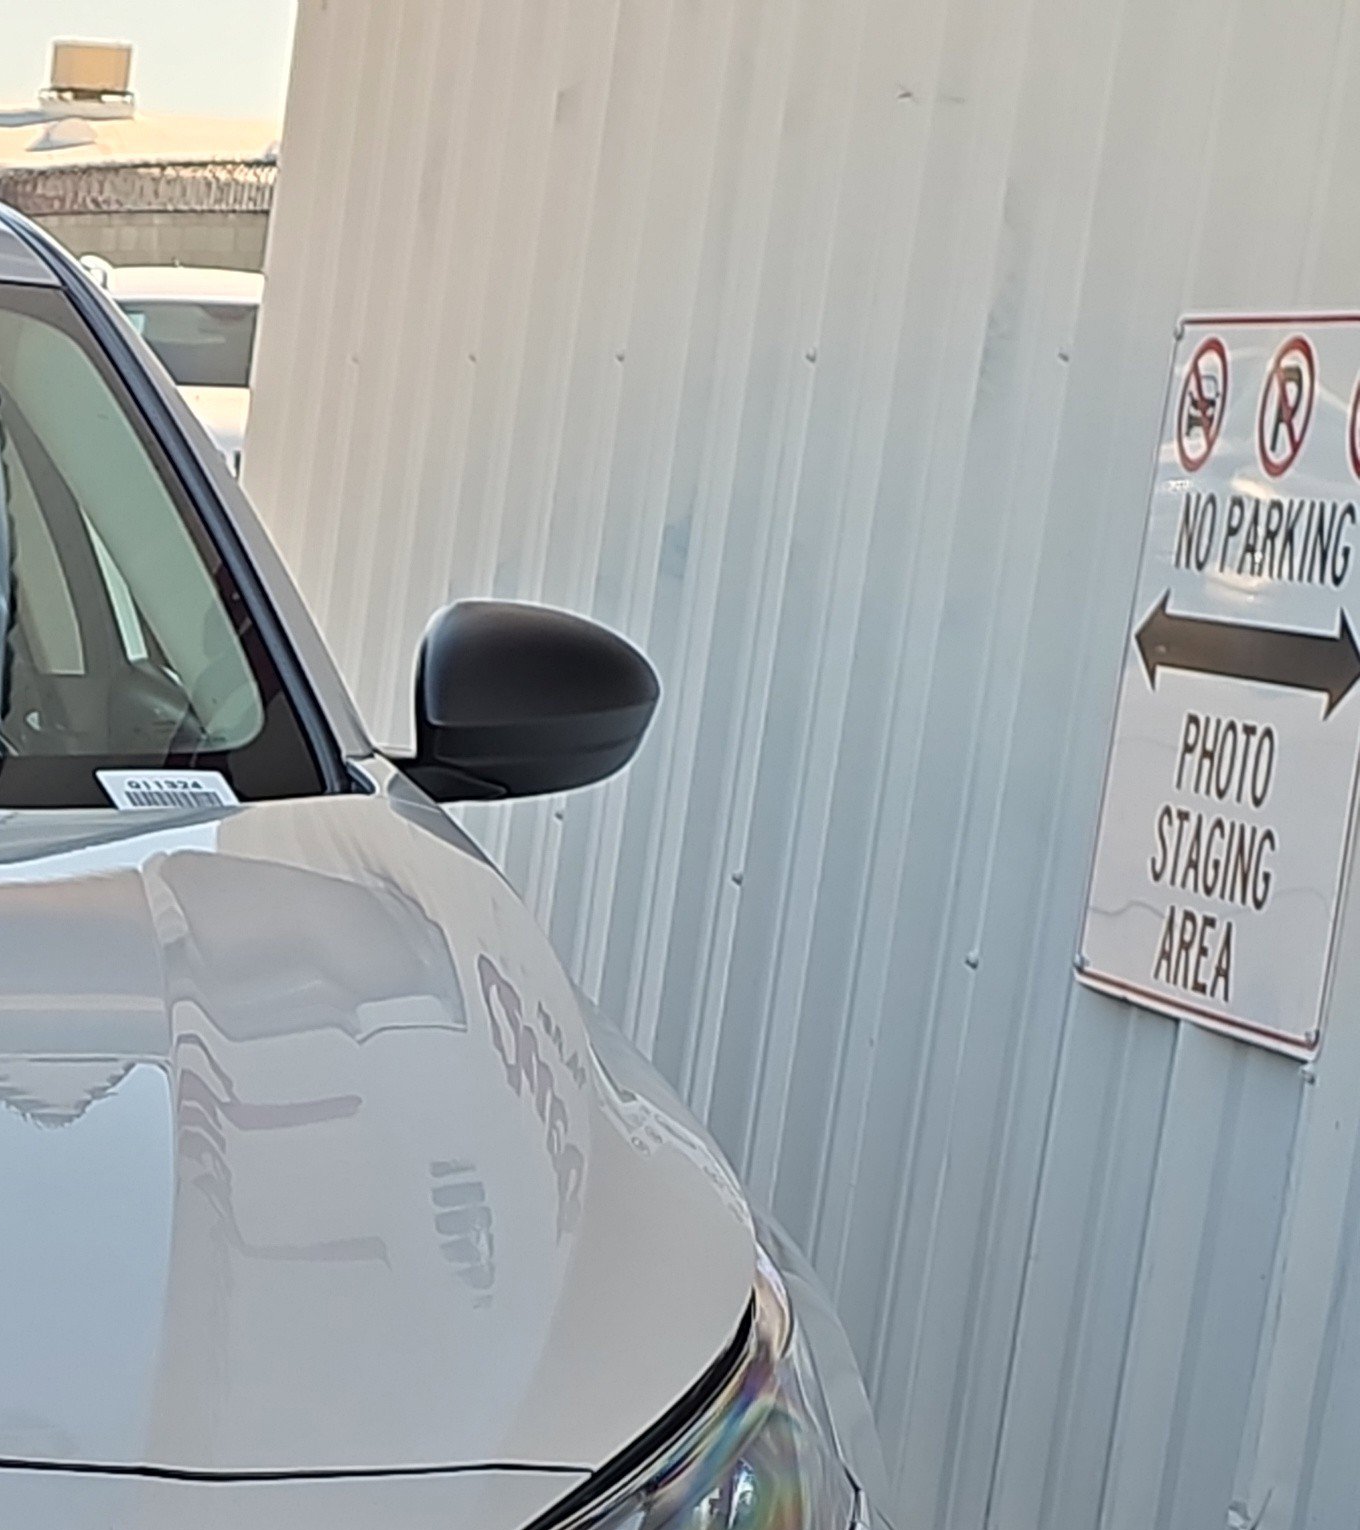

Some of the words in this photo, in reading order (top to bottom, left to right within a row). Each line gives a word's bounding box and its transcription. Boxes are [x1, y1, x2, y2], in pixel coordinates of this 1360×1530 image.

[1174, 491, 1217, 572] NO
[1218, 497, 1357, 588] PARKING
[1176, 712, 1275, 808] PHOTO
[1150, 804, 1276, 911] STAGING
[1153, 904, 1232, 1003] AREA
